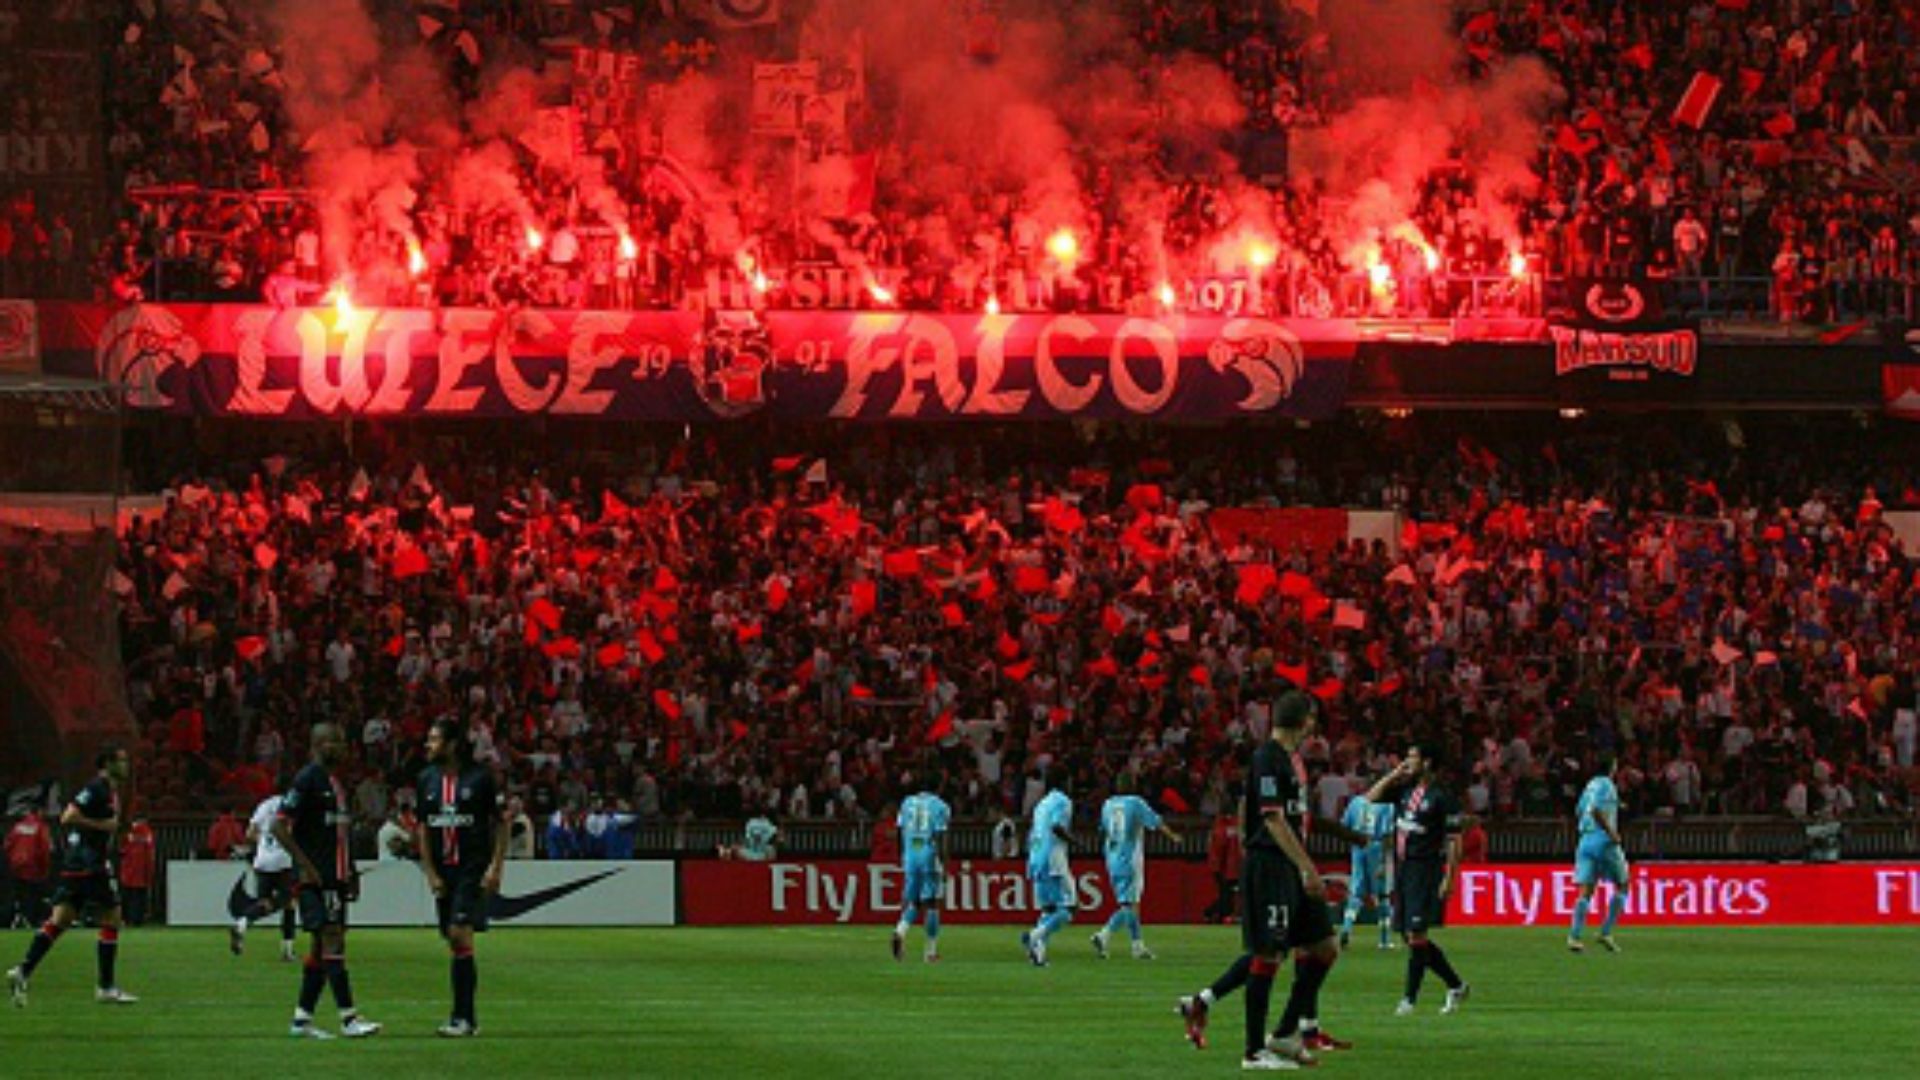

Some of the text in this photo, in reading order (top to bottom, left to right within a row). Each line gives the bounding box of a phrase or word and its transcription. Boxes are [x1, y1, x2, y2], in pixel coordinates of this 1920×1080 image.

[226, 309, 1180, 418] LUTECE 19 91 FALCO
[769, 862, 857, 922] Fly
[1267, 904, 1290, 929] 21
[1460, 870, 1542, 925] Fly
